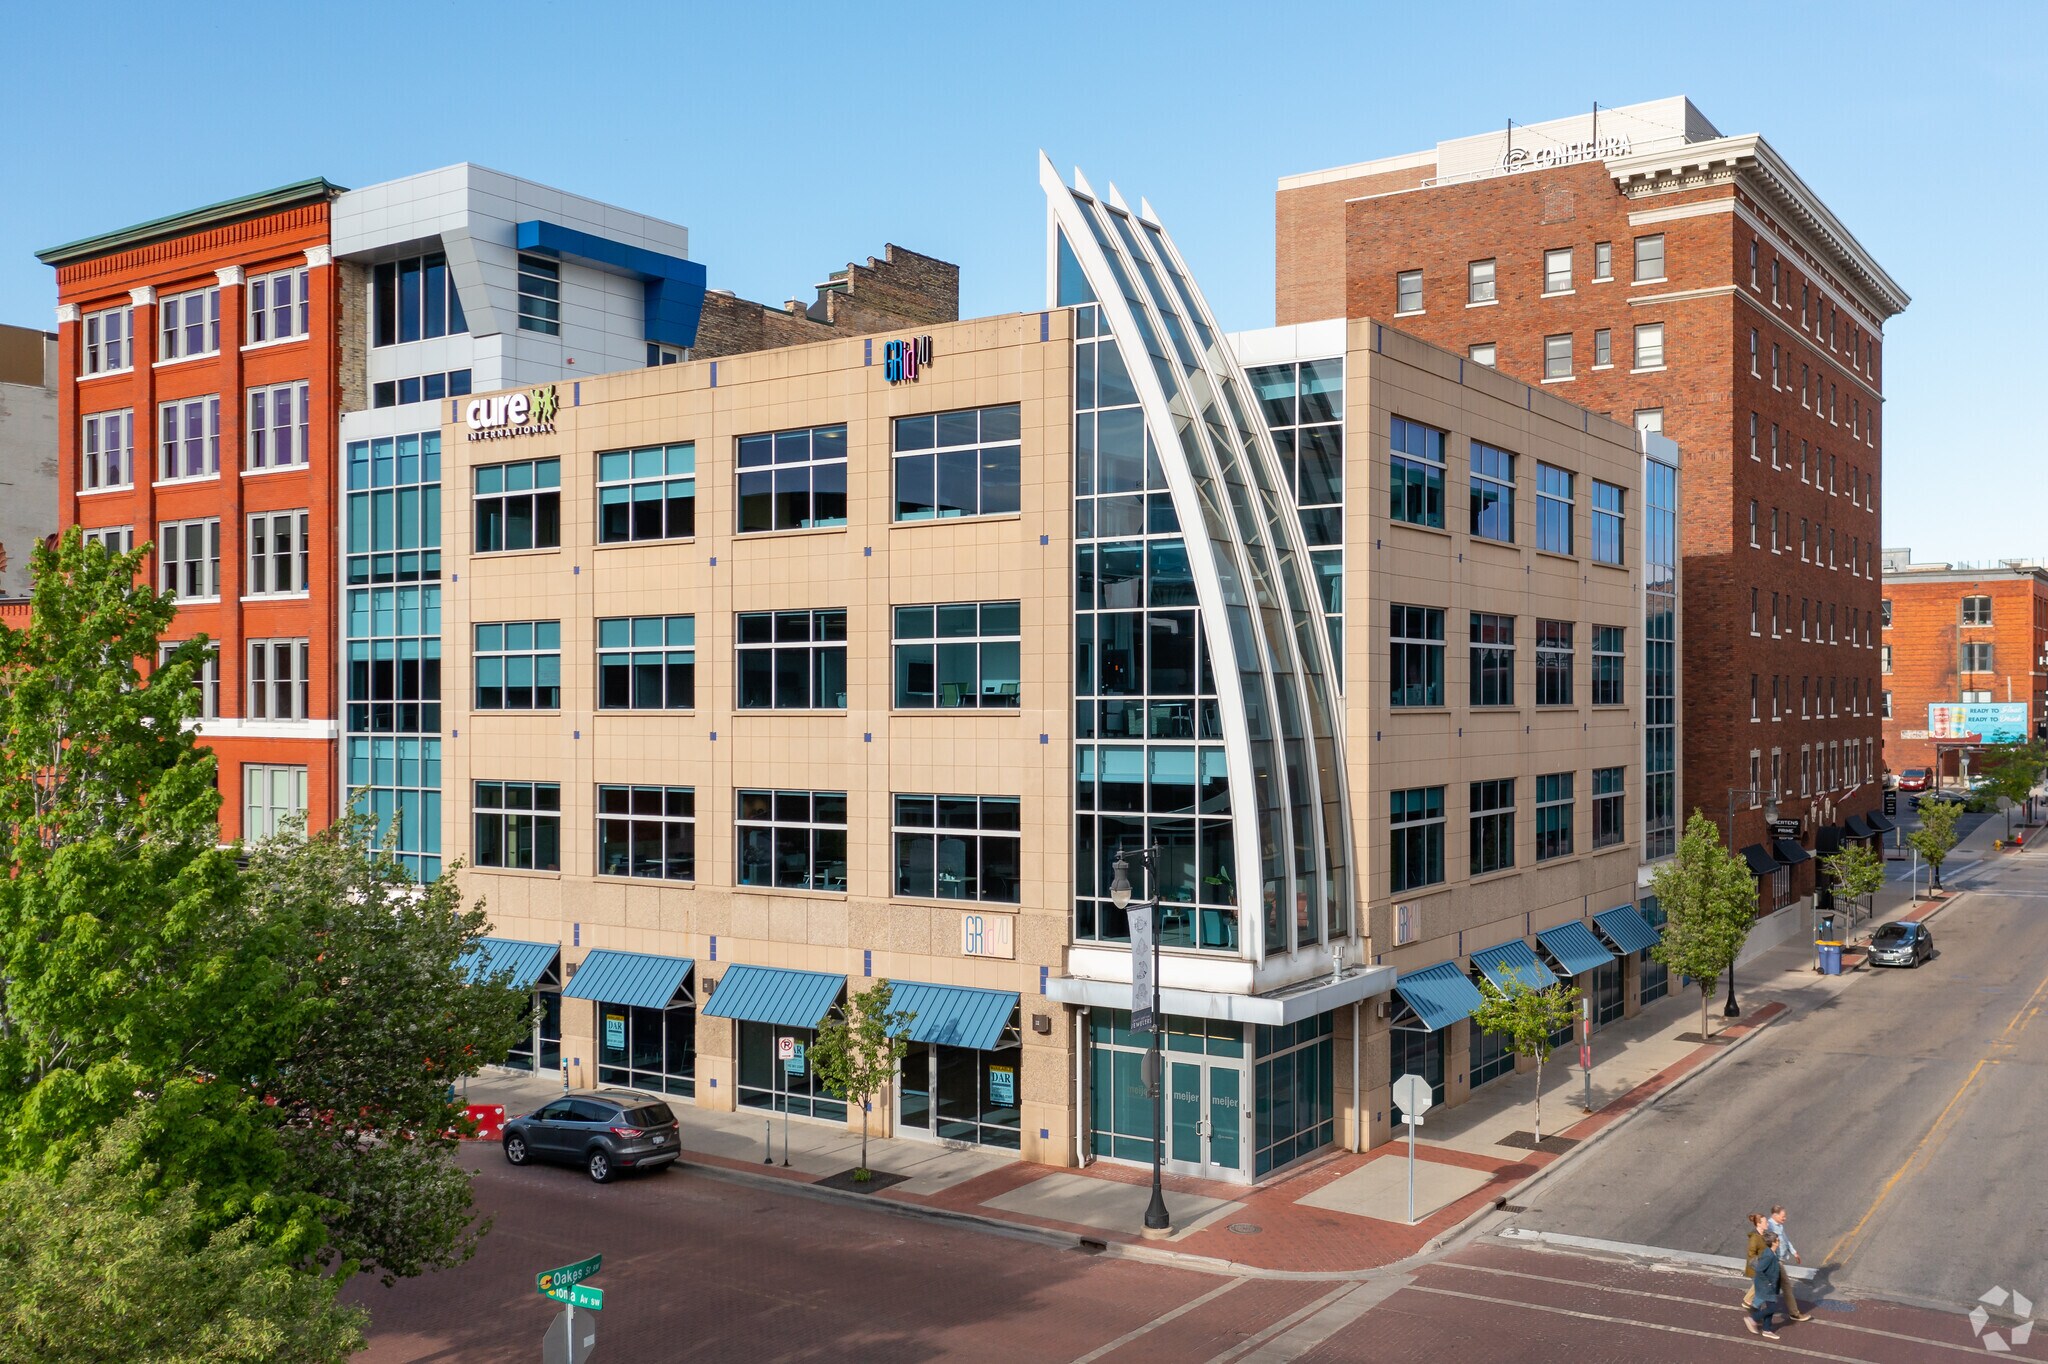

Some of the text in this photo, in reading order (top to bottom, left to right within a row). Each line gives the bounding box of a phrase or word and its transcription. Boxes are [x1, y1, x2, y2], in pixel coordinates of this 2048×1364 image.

[1534, 136, 1632, 168] CONFIGURA
[466, 393, 529, 429] cure
[468, 423, 554, 442] INTERNATIONAL
[608, 1020, 623, 1031] DAR
[991, 1072, 1011, 1083] DAR
[1173, 1091, 1199, 1103] meijer
[1212, 1096, 1238, 1108] meijer
[553, 1269, 583, 1286] Oakes
[580, 1294, 588, 1304] Av
